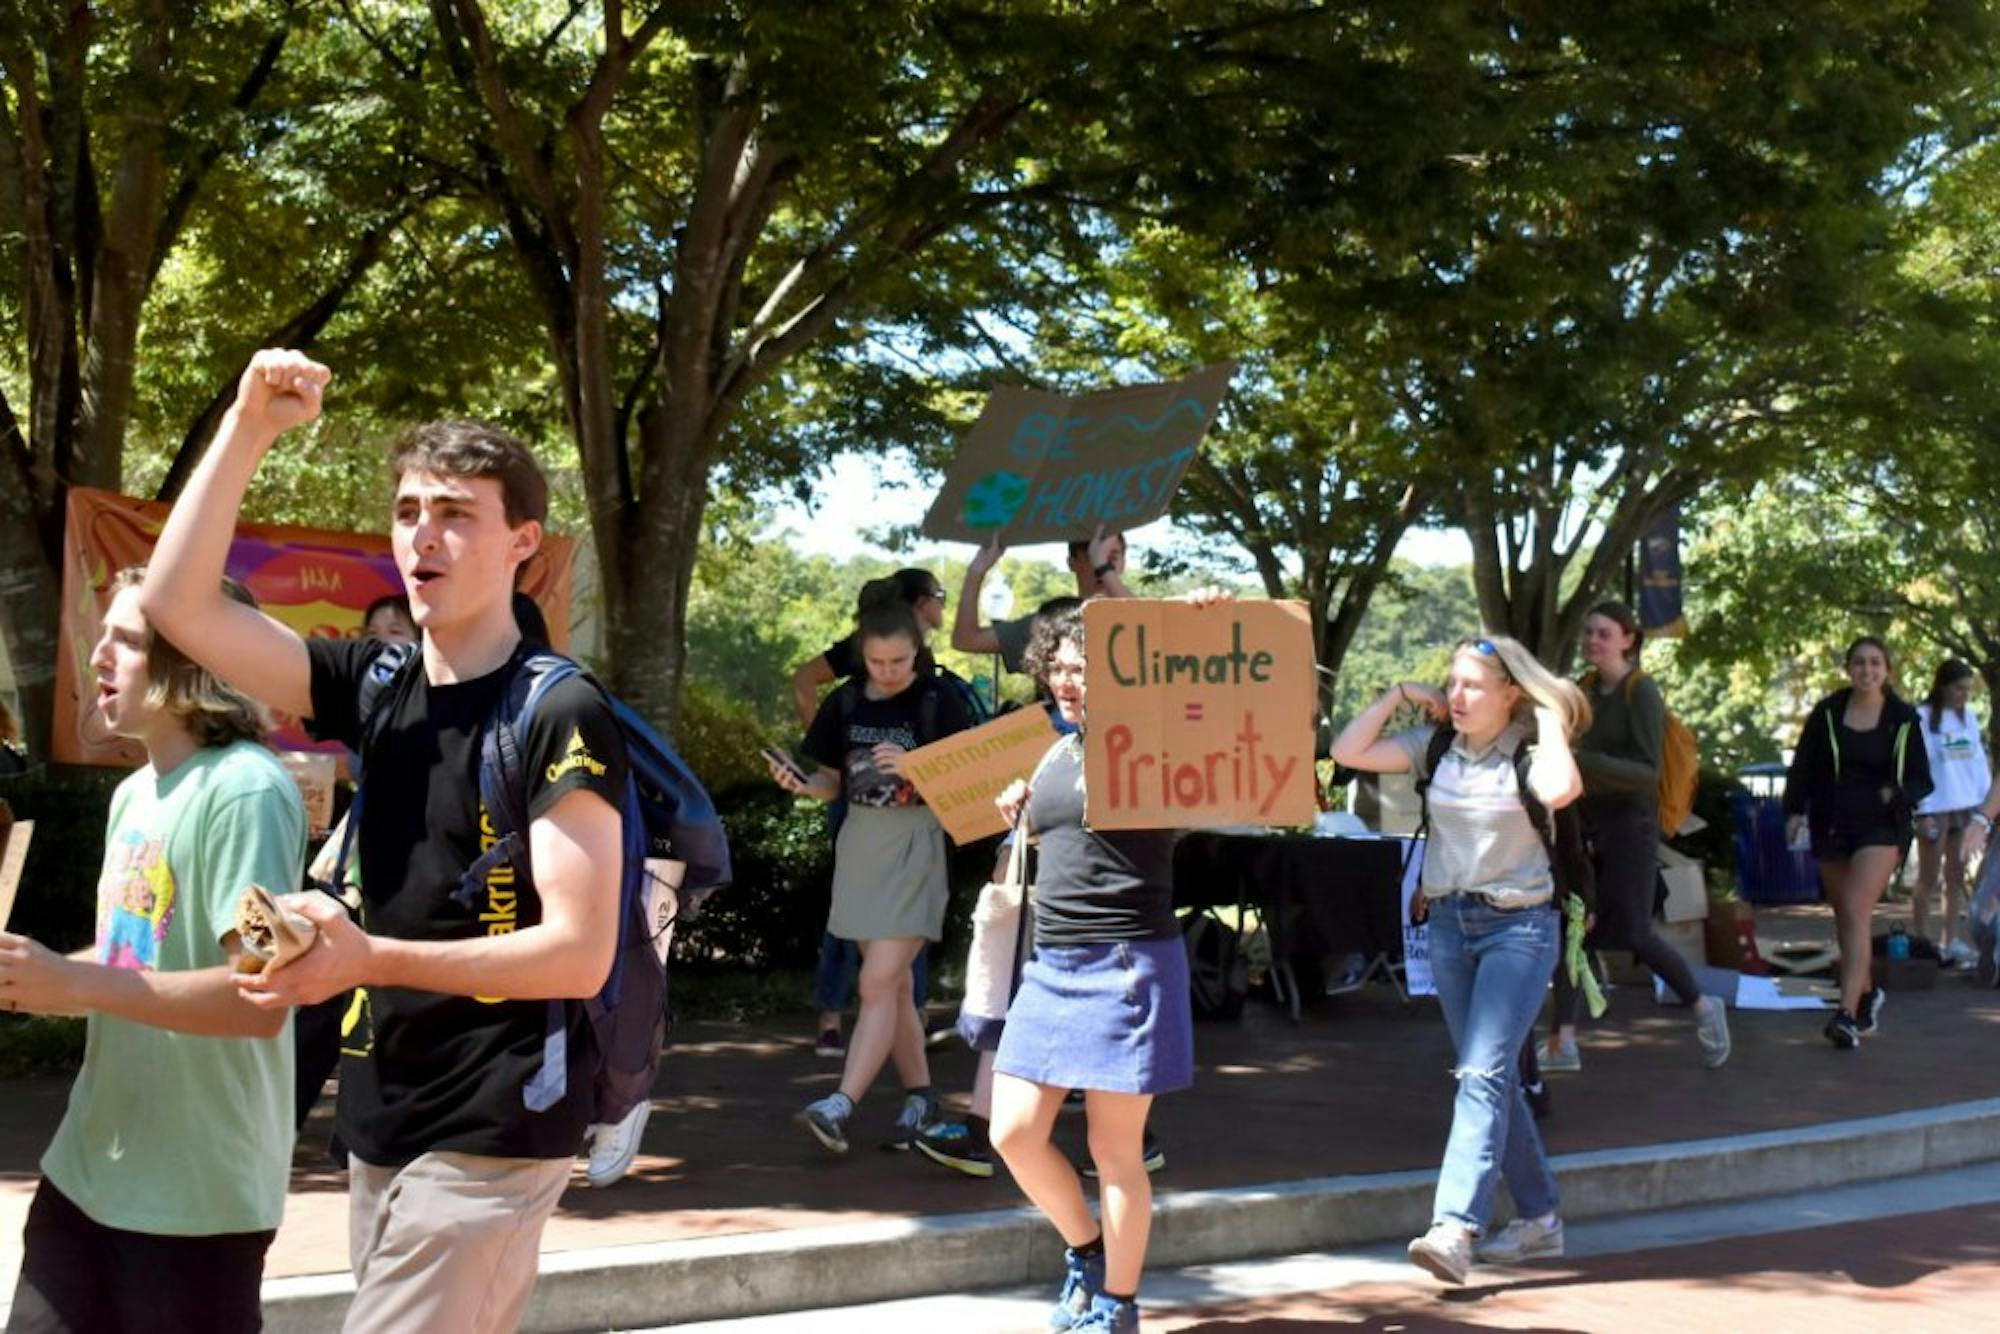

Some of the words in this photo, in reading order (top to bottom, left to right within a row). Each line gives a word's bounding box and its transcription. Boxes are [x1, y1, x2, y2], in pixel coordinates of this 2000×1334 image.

[1013, 413, 1086, 462] BE
[1024, 448, 1194, 527] HONEST
[1107, 620, 1274, 687] Climate
[1105, 710, 1297, 816] Priority
